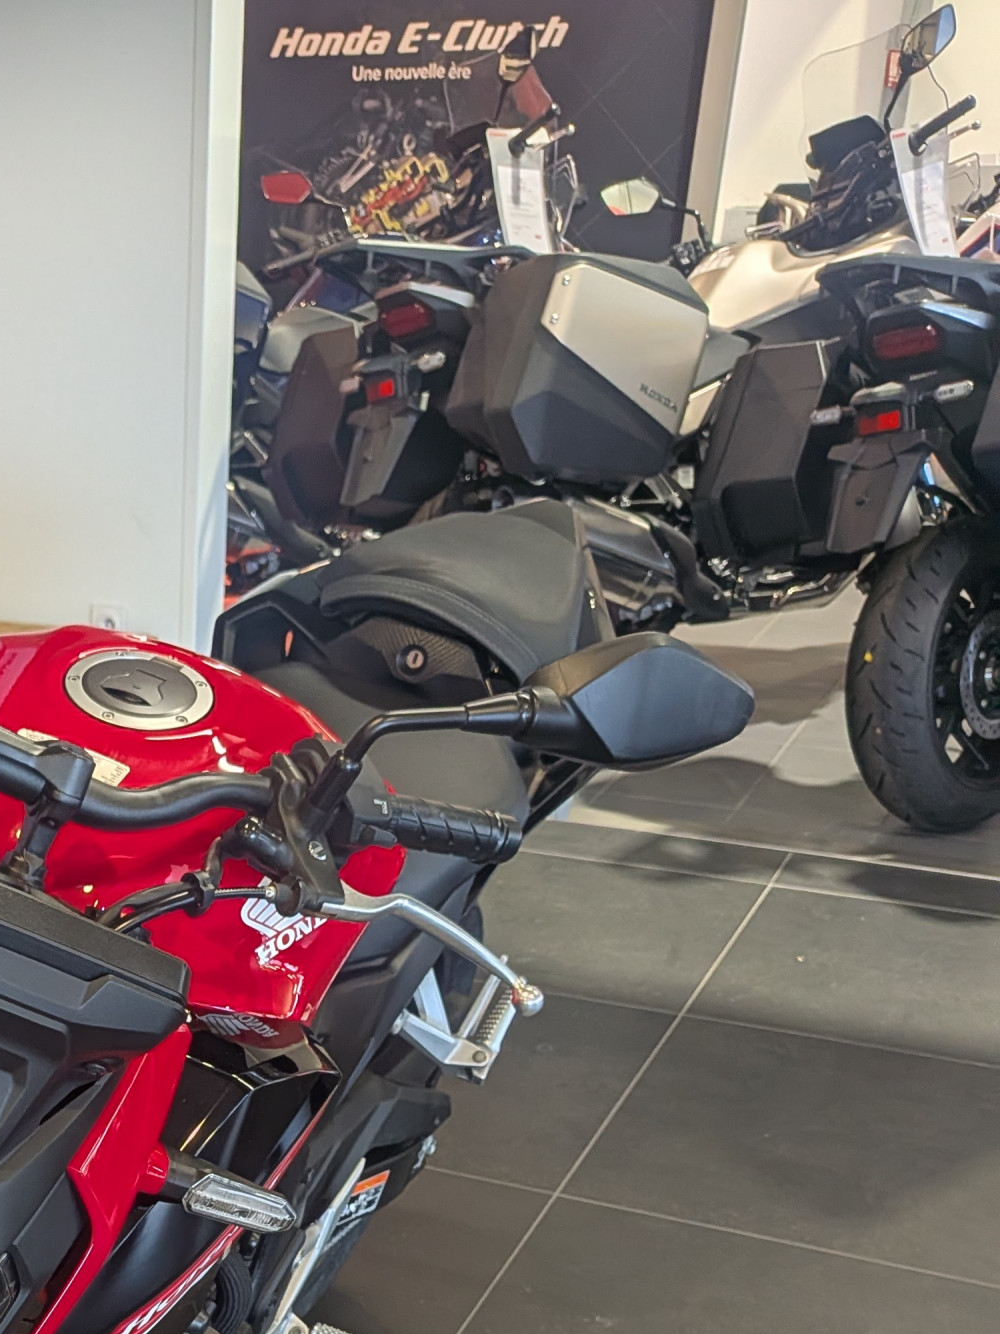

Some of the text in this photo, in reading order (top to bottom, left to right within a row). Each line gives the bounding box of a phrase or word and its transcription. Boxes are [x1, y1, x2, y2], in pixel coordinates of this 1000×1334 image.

[270, 15, 569, 58] Honda E-Cluth
[352, 61, 471, 82] Une nouvelle ère
[255, 916, 328, 966] HON
